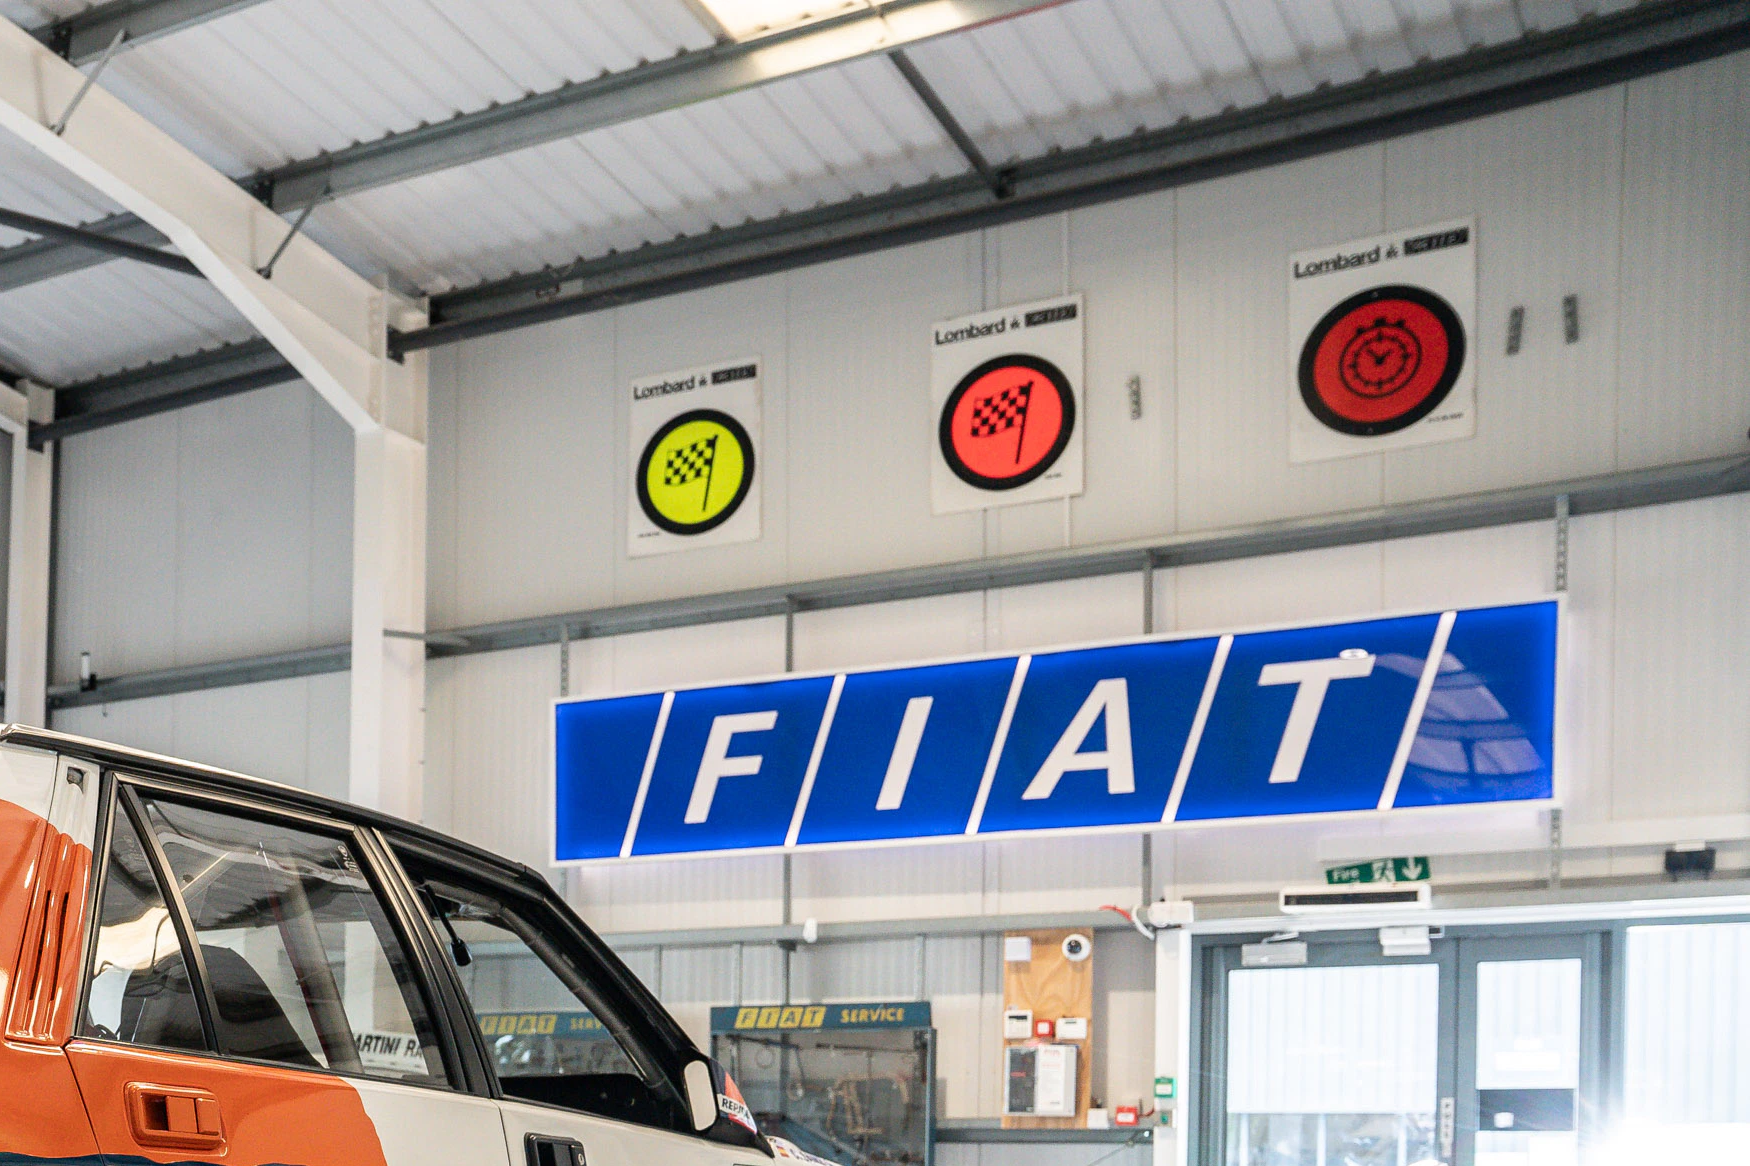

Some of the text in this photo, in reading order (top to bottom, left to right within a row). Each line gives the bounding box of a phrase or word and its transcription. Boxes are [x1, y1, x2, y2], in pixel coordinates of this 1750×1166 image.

[1293, 245, 1381, 279] Lombard
[935, 318, 1006, 345] Lombard
[633, 376, 695, 400] Lombard
[684, 653, 1375, 824] FIAT
[570, 1017, 601, 1031] SERV
[734, 1006, 905, 1029] FIAT SERVICE
[354, 1034, 401, 1055] ARTINI
